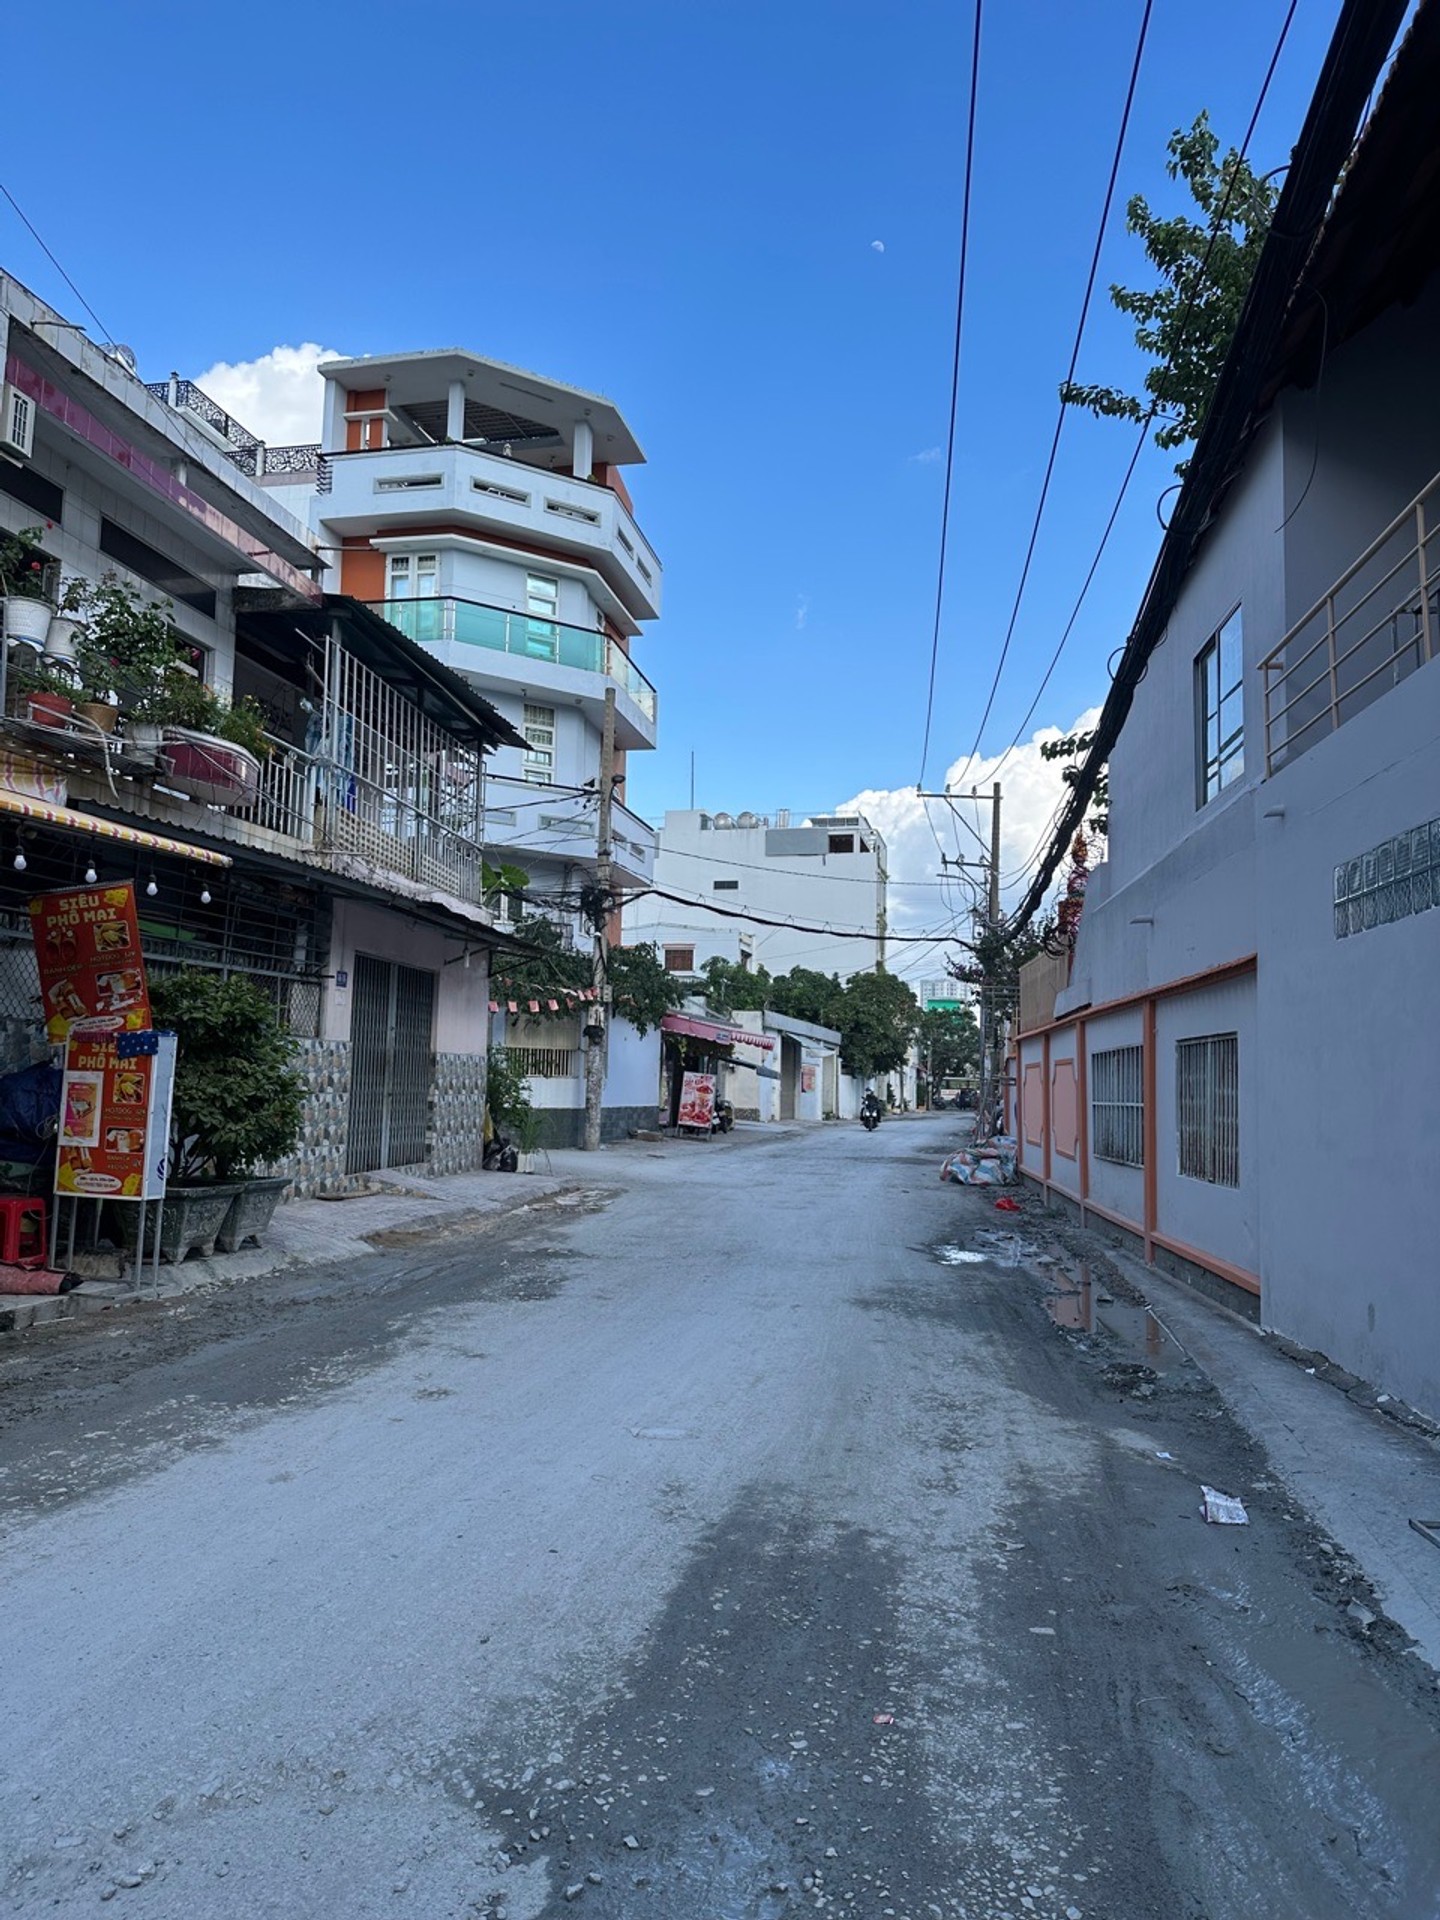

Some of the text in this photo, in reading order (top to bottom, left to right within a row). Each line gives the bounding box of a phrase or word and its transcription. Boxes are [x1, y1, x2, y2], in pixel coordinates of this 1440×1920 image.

[59, 893, 100, 910] SIÊU
[83, 907, 117, 923] MAI
[109, 1057, 138, 1070] MAI
